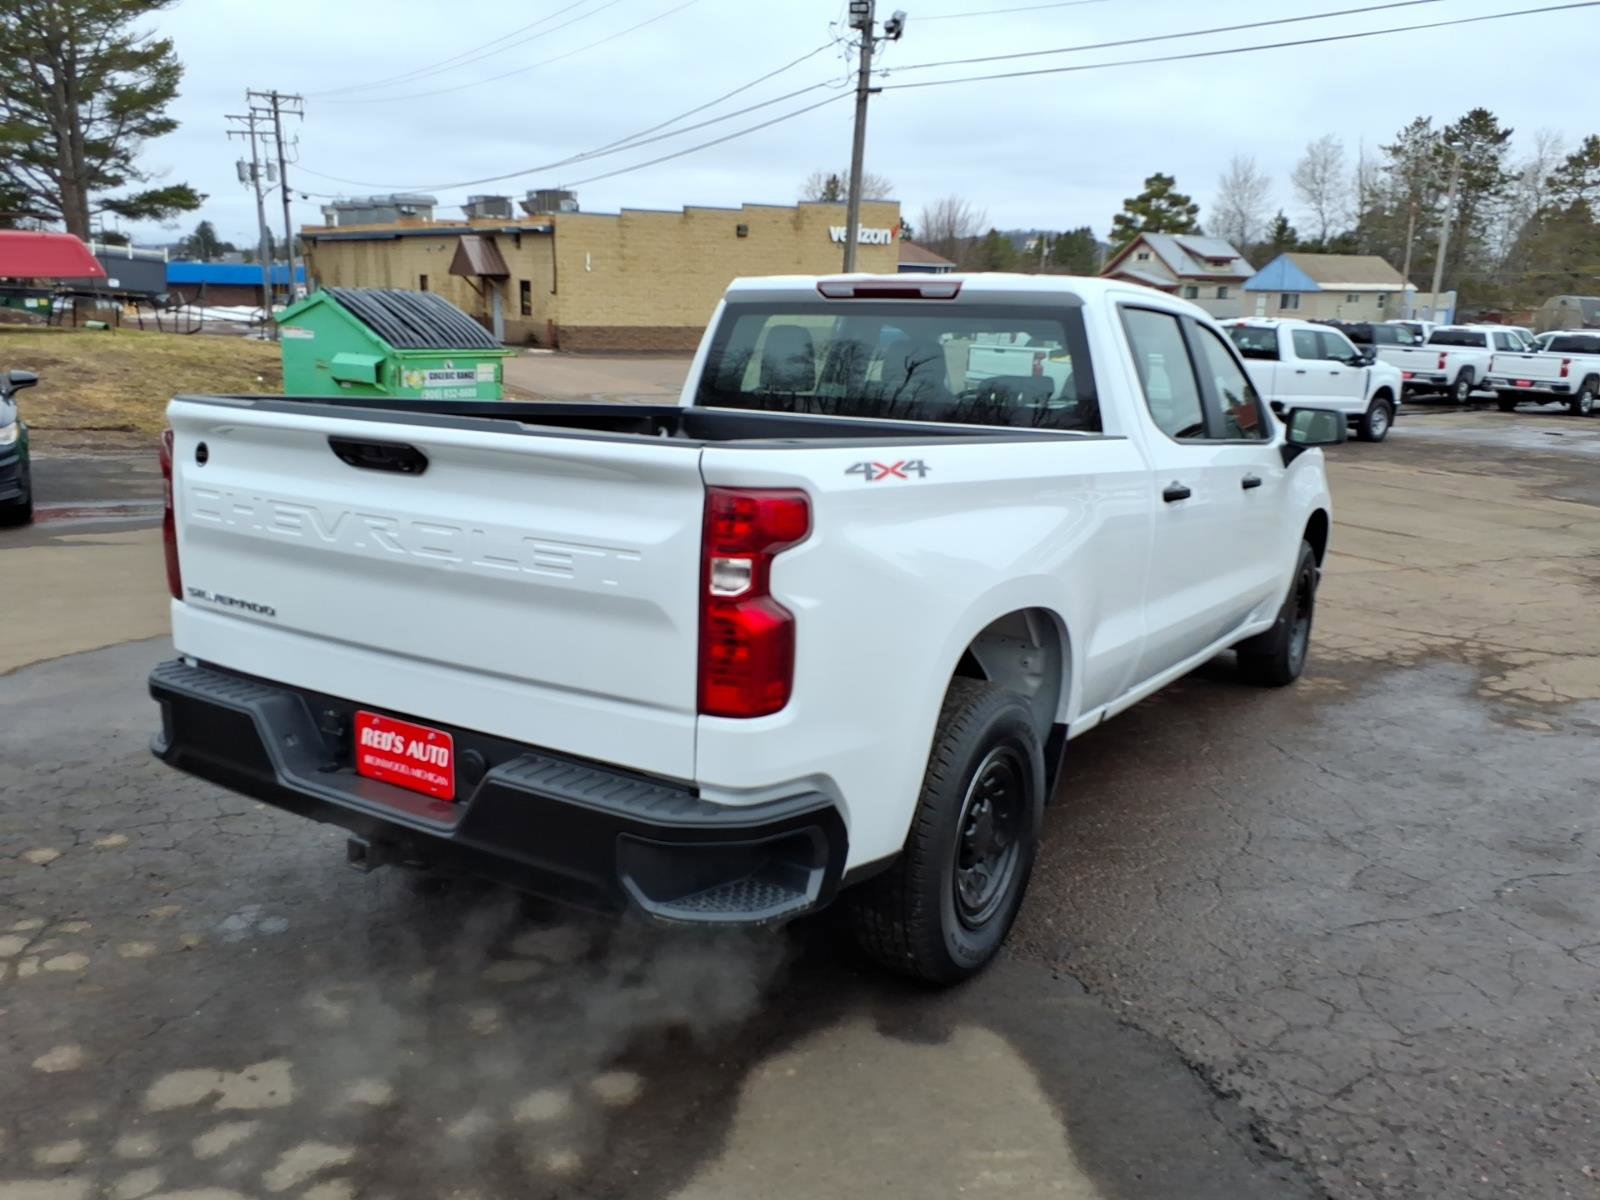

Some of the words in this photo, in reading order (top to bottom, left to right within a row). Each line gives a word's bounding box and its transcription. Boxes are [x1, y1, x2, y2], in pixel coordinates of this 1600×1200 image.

[828, 223, 892, 244] veizon
[190, 486, 643, 586] CHEVROLET
[187, 586, 276, 617] SILVERADO
[361, 726, 405, 755] RED'S
[405, 740, 449, 768] AUTO
